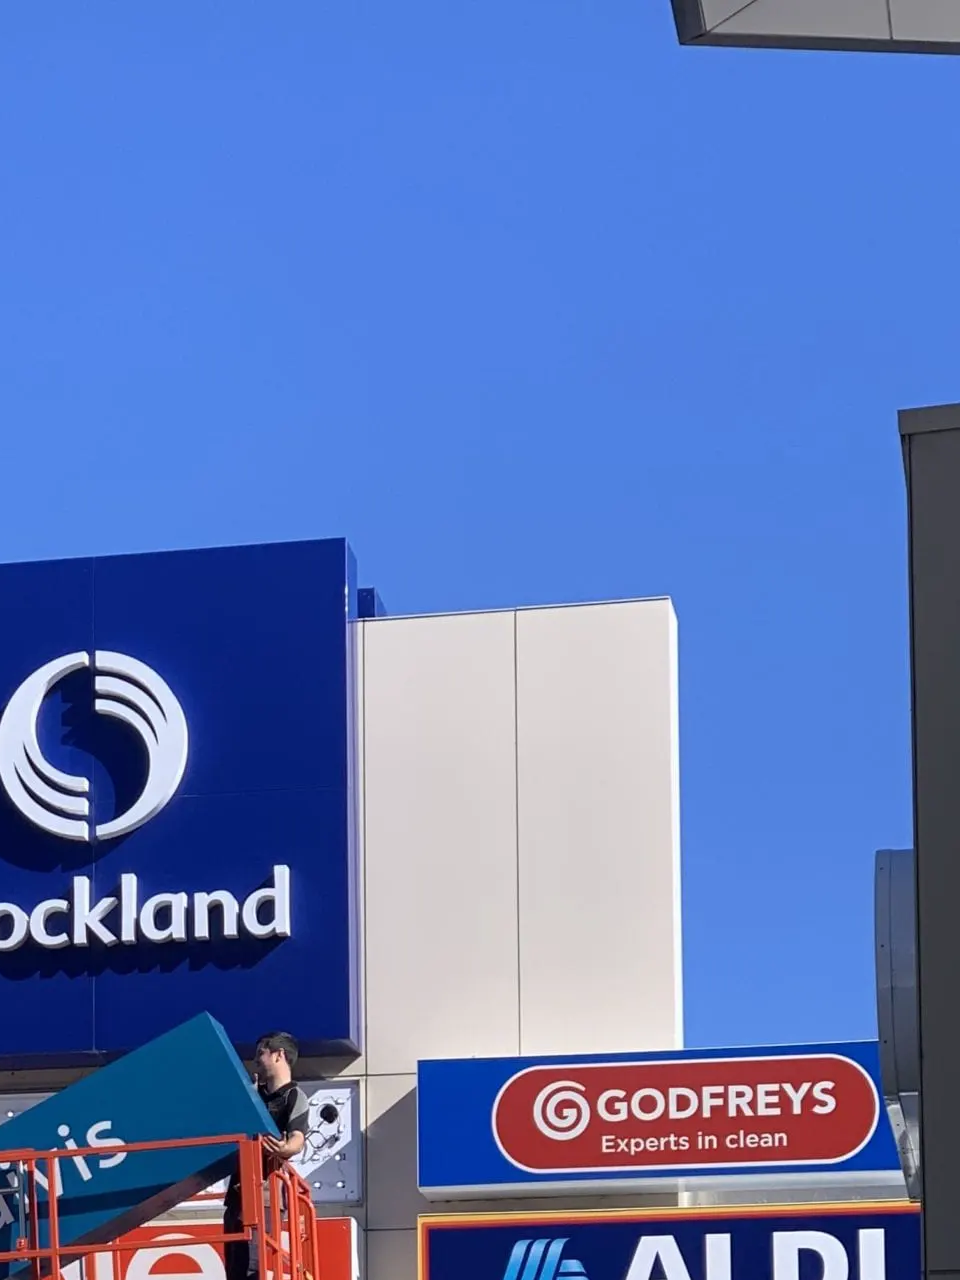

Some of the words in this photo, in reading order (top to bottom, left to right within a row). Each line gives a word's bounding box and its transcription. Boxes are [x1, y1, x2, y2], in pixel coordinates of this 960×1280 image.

[596, 1080, 837, 1122] GODFREYS
[600, 1132, 689, 1155] Experts
[697, 1130, 718, 1150] in
[725, 1129, 788, 1149] clean
